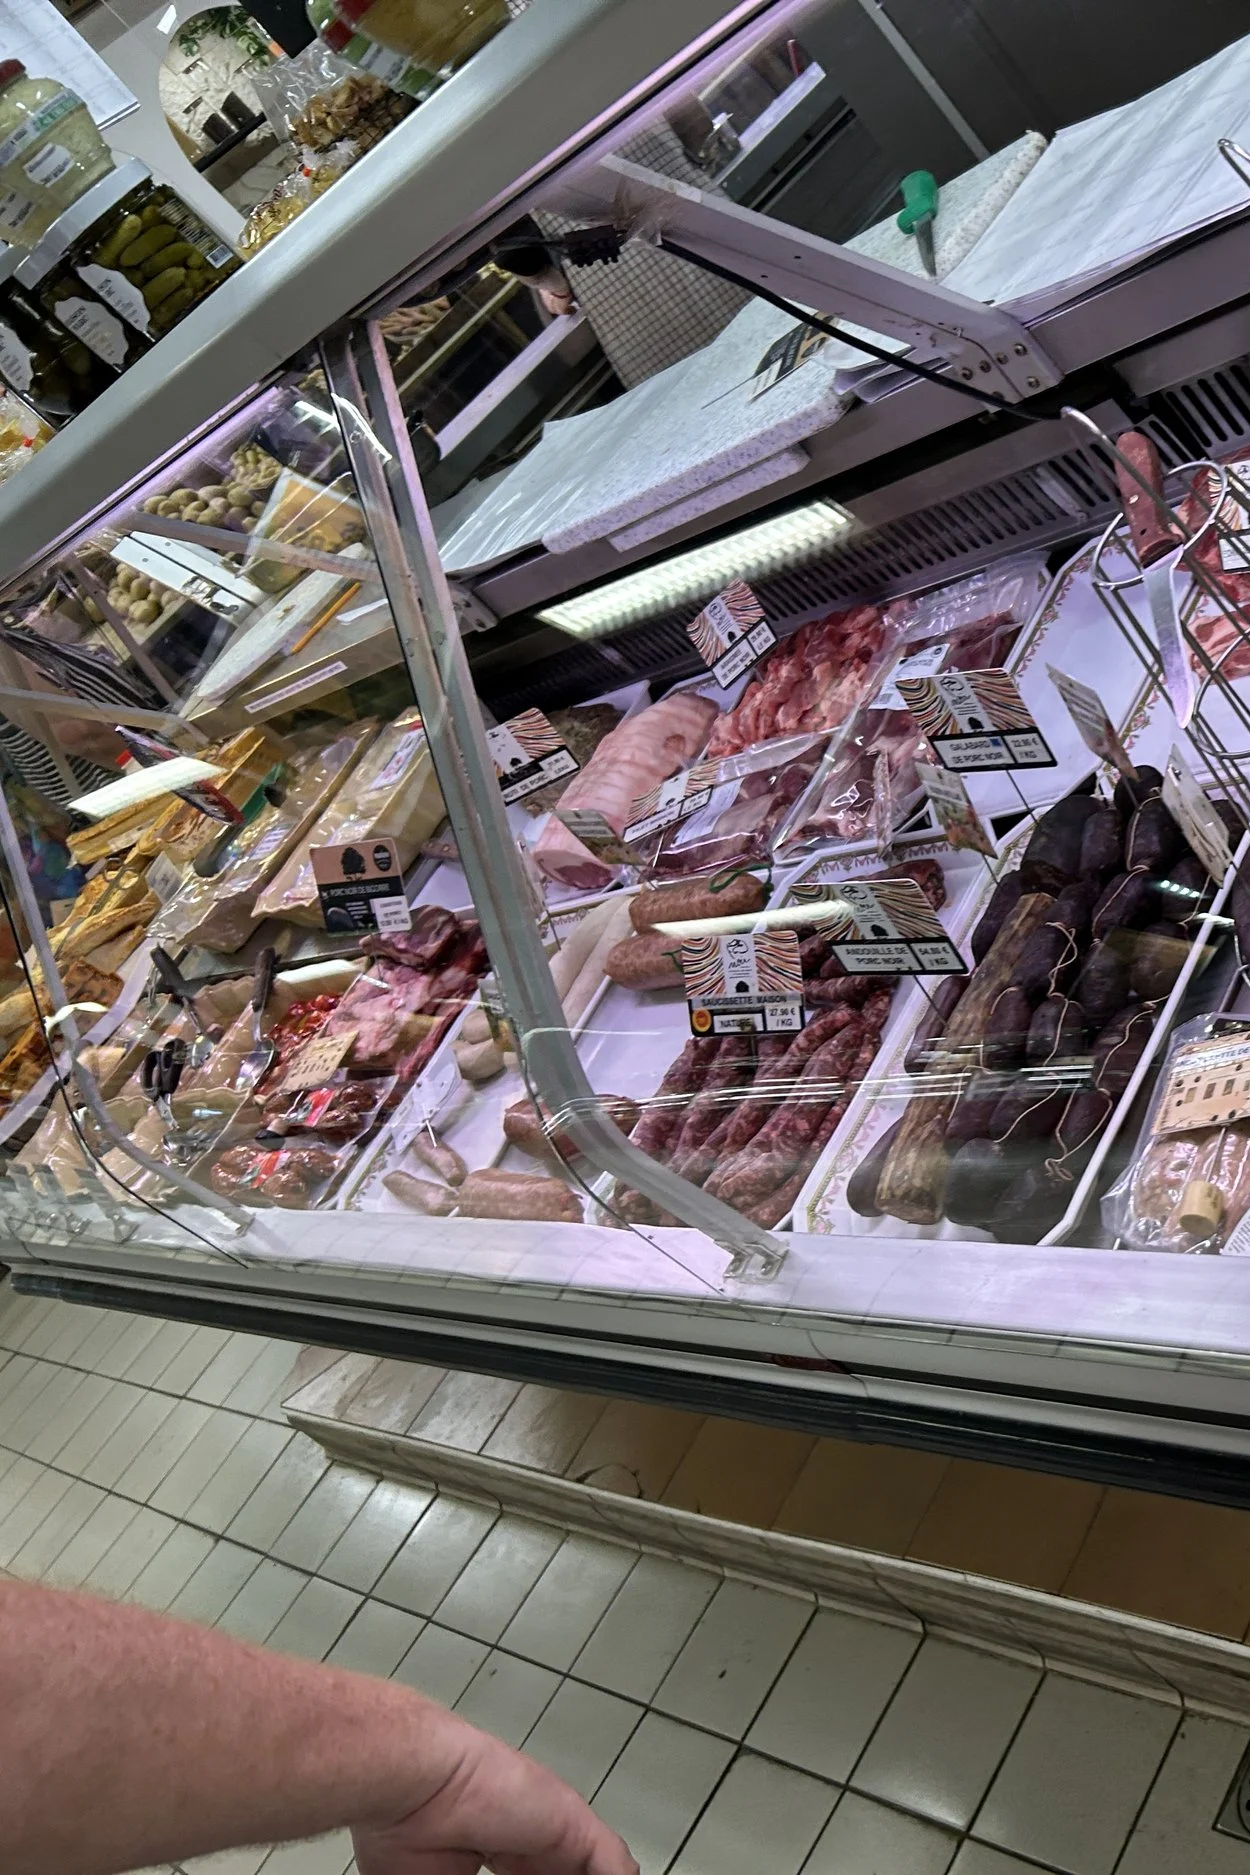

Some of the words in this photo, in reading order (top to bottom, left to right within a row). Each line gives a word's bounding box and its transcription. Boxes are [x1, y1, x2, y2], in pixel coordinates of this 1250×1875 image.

[845, 947, 895, 956] ANDOUILLE
[896, 946, 909, 955] DE
[702, 995, 754, 1007] SAUCISSETTE
[757, 994, 788, 1004] MAISON
[720, 1018, 752, 1029] NATURE
[780, 1018, 794, 1027] KG
